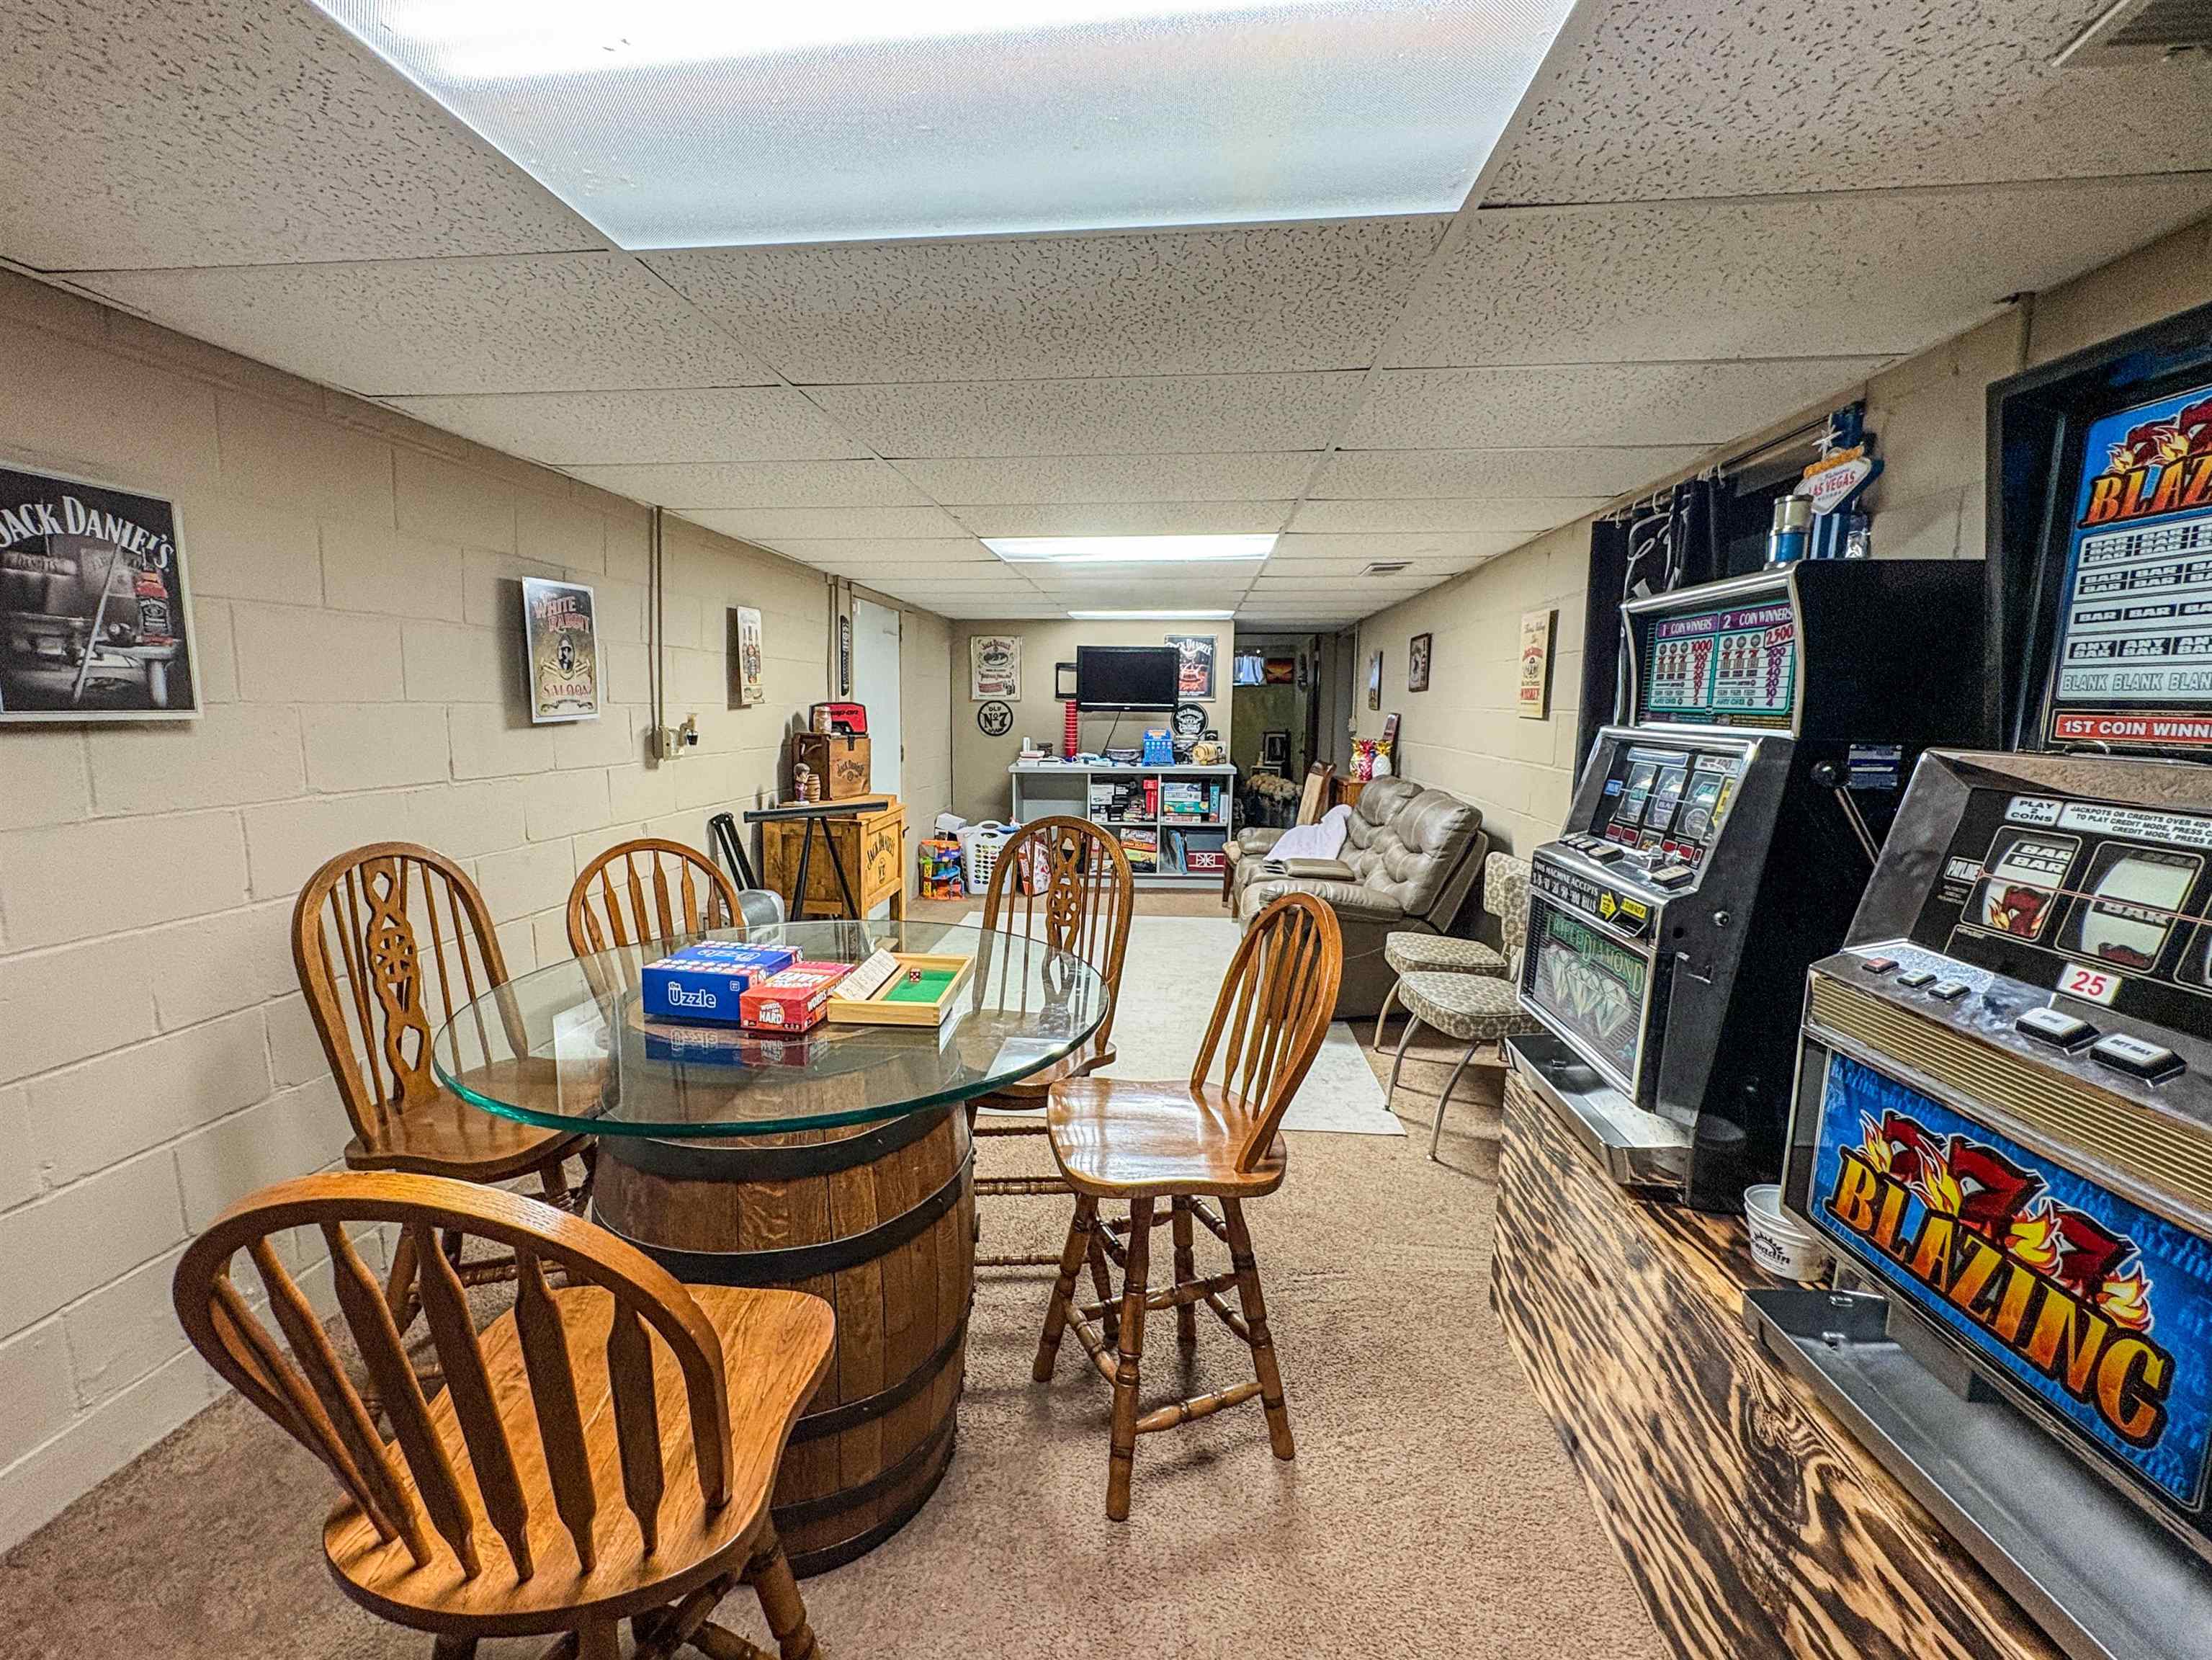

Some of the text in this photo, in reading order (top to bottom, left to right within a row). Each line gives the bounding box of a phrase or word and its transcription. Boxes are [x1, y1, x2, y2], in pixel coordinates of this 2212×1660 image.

[1826, 471, 1856, 492] VEGAS
[0, 503, 63, 548] JACK
[2085, 573, 2122, 584] BAR
[2136, 566, 2177, 577] BAR
[2083, 583, 2121, 593] BAR
[2133, 576, 2175, 588] BAR
[533, 595, 576, 618] WHITE
[2079, 602, 2212, 622] BAR BAR BA
[549, 612, 590, 633] RABBIT
[1723, 615, 1732, 630] 2
[1739, 612, 1757, 626] COIN
[1662, 625, 1667, 636] 1
[2074, 645, 2212, 658] BAR BAR BA
[2125, 639, 2166, 648] ANY
[2179, 637, 2212, 646] AN
[542, 684, 591, 698] SALOON
[2062, 672, 2212, 692] BLANK BLANK BLAN
[2064, 720, 2212, 739] 1ST COIN WINN
[2019, 800, 2055, 809] PLAY
[2011, 812, 2052, 822] COINS
[2071, 806, 2111, 816] JACKPOTS
[2127, 813, 2165, 823] CREDITS
[2166, 818, 2191, 826] OVER
[2110, 818, 2141, 827] CREDIT
[2143, 822, 2170, 831] MODE,
[2172, 826, 2203, 836] PRESS
[2112, 826, 2144, 835] CREDIT
[2174, 834, 2206, 844] PRESS
[2020, 844, 2073, 861] BAR
[2010, 856, 2067, 873] BAR
[2103, 901, 2170, 925] BAR
[2070, 970, 2108, 996] 25
[668, 988, 717, 1008] Uzzle
[759, 1010, 783, 1025] HARD
[2110, 1038, 2153, 1056] BET MAX
[1830, 1154, 2168, 1441] BLAZING
